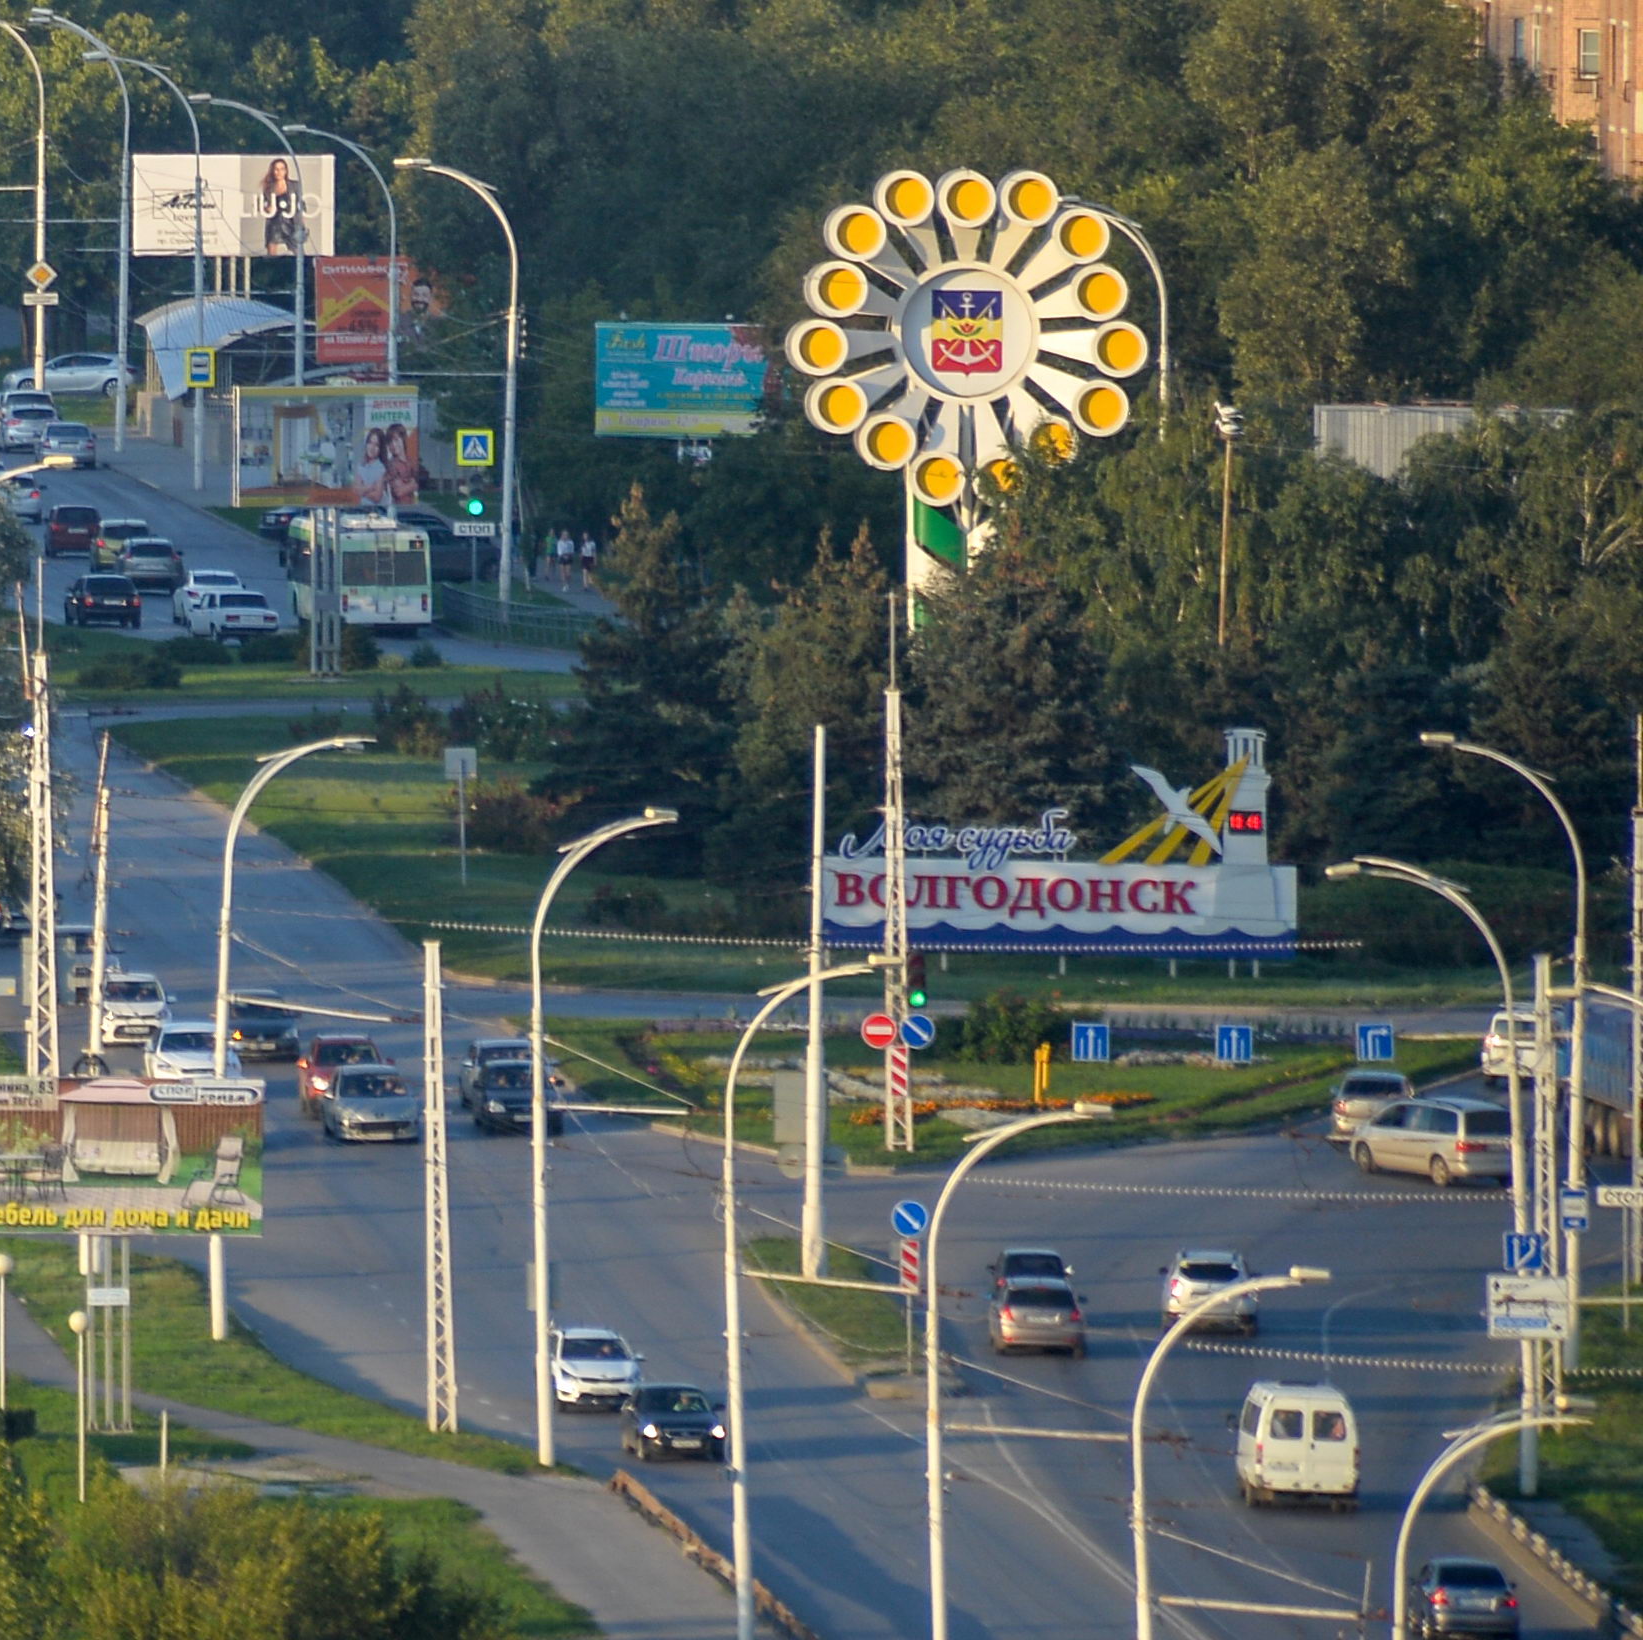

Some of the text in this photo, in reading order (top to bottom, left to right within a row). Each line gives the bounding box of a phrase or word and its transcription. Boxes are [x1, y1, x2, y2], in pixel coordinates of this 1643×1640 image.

[458, 524, 491, 535] СТОП
[956, 808, 1077, 871] судьба
[833, 871, 1197, 919] ВОЛГОДОНСК
[64, 1208, 107, 1229] для
[113, 1208, 170, 1229] дома
[175, 1209, 190, 1227] и
[194, 1207, 251, 1231] дачи
